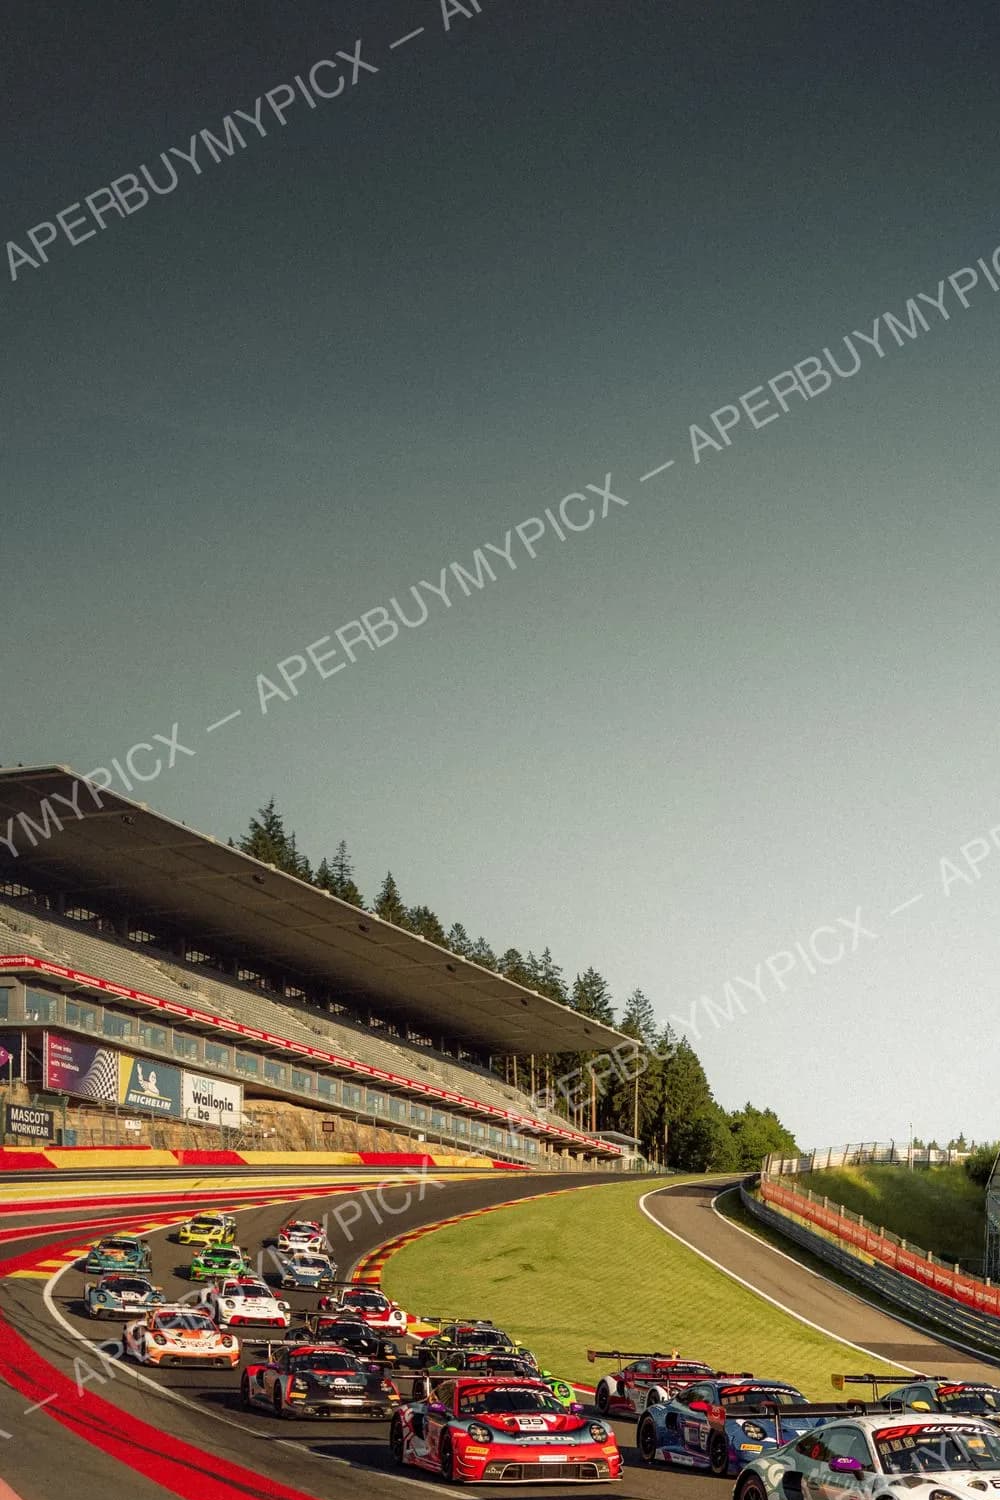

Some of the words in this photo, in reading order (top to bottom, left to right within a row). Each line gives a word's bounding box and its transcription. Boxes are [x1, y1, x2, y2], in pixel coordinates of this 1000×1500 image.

[192, 1077, 216, 1091] VISIT
[128, 1093, 172, 1111] MICHELIN
[192, 1091, 234, 1112] Wallonia
[11, 1122, 49, 1136] WORKWEAR
[518, 1418, 544, 1426] 89
